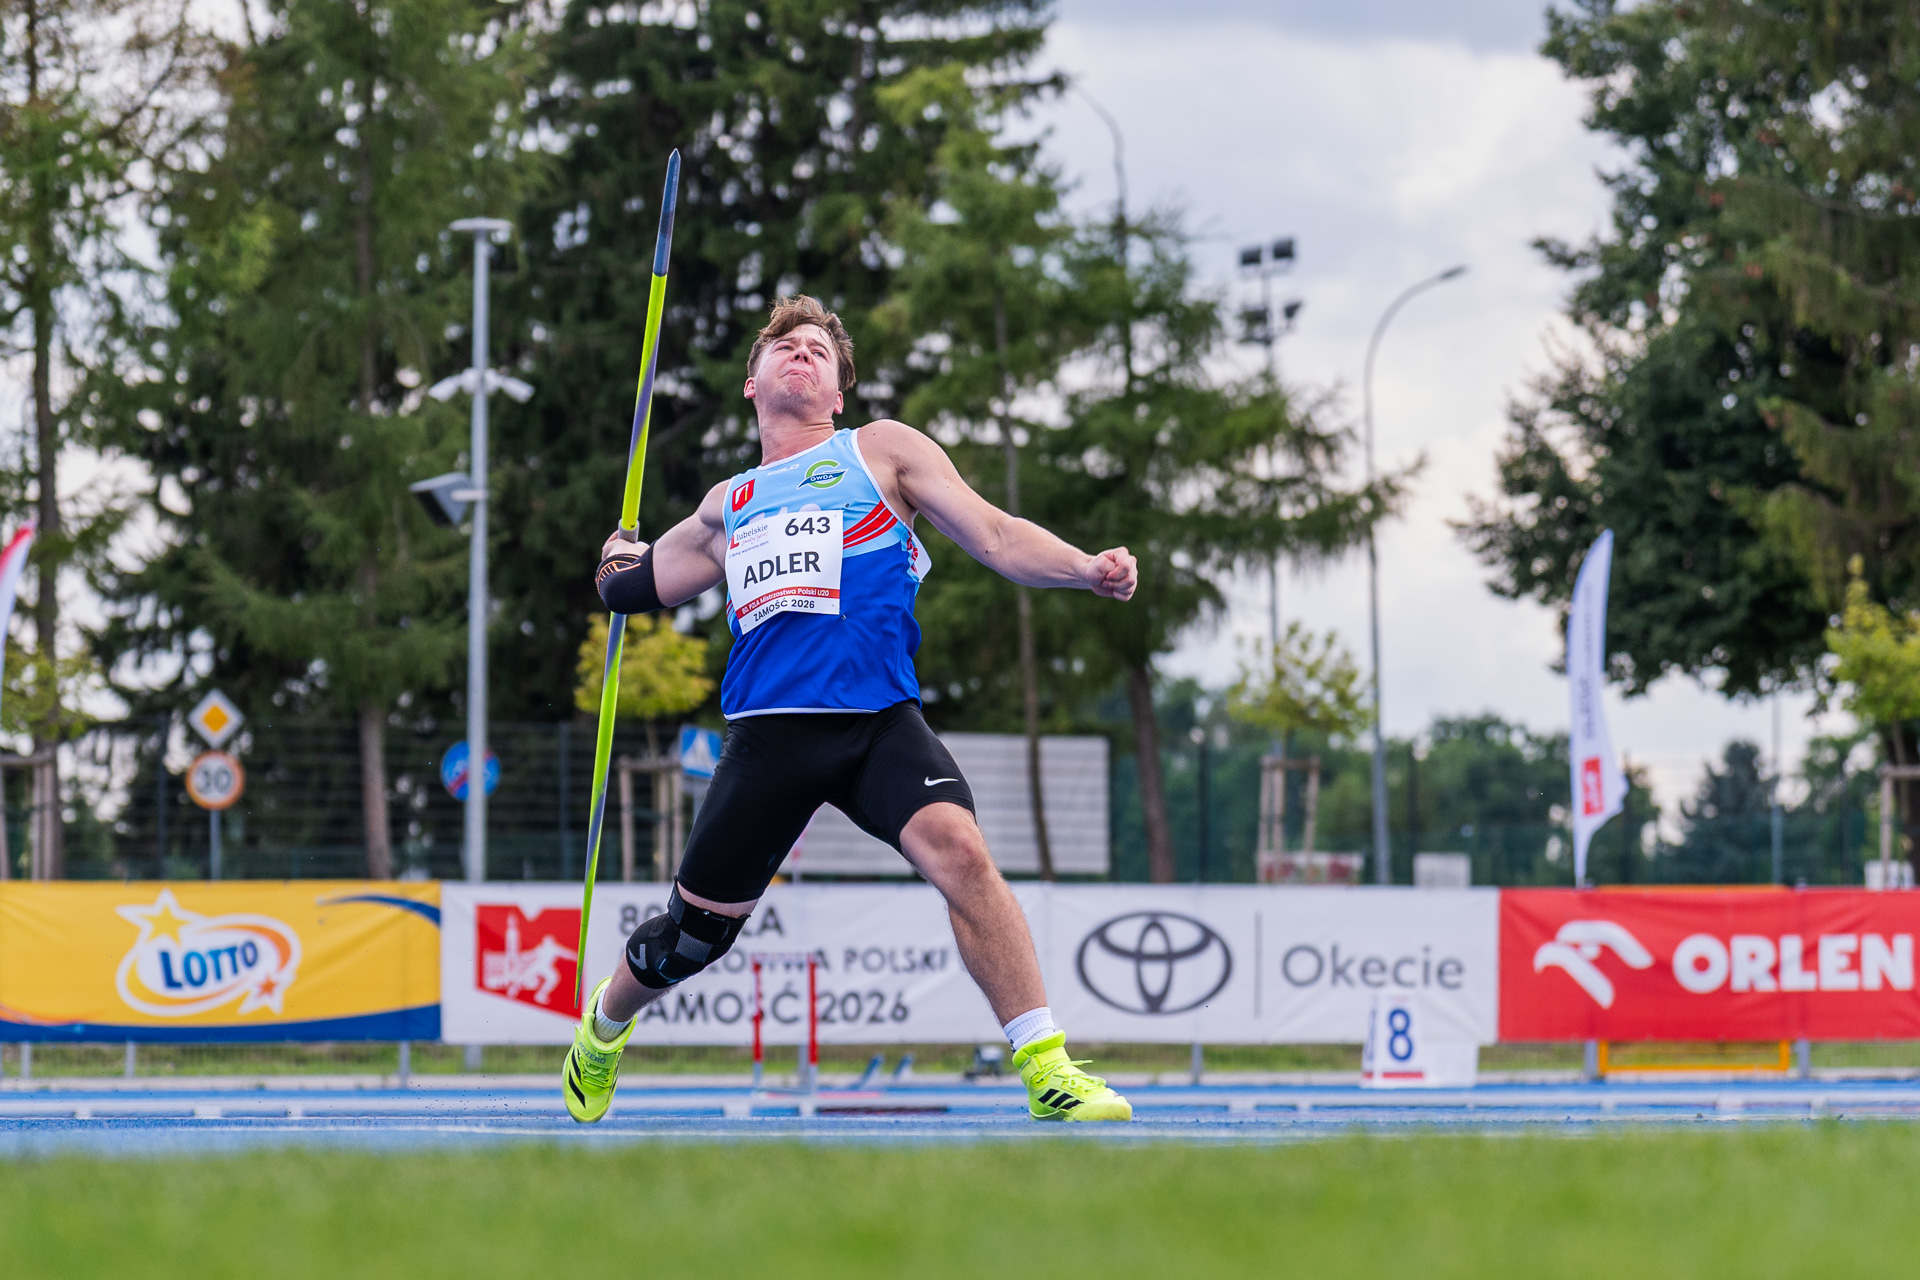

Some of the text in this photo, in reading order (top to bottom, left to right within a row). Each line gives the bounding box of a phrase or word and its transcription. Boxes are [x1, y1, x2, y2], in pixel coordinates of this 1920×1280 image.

[784, 516, 831, 536] 643
[743, 551, 821, 589] ADLER
[753, 597, 815, 622] ZAMOŚĆ 2026
[760, 588, 797, 603] Mistrzostwa
[797, 588, 817, 596] Polski
[159, 941, 259, 989] LOTTO
[845, 949, 948, 973] POLSKI
[1282, 941, 1465, 991] Okecie
[1672, 932, 1914, 994] ORLEN
[643, 980, 909, 1024] AMOĆ 2026
[1388, 1007, 1413, 1062] 8
